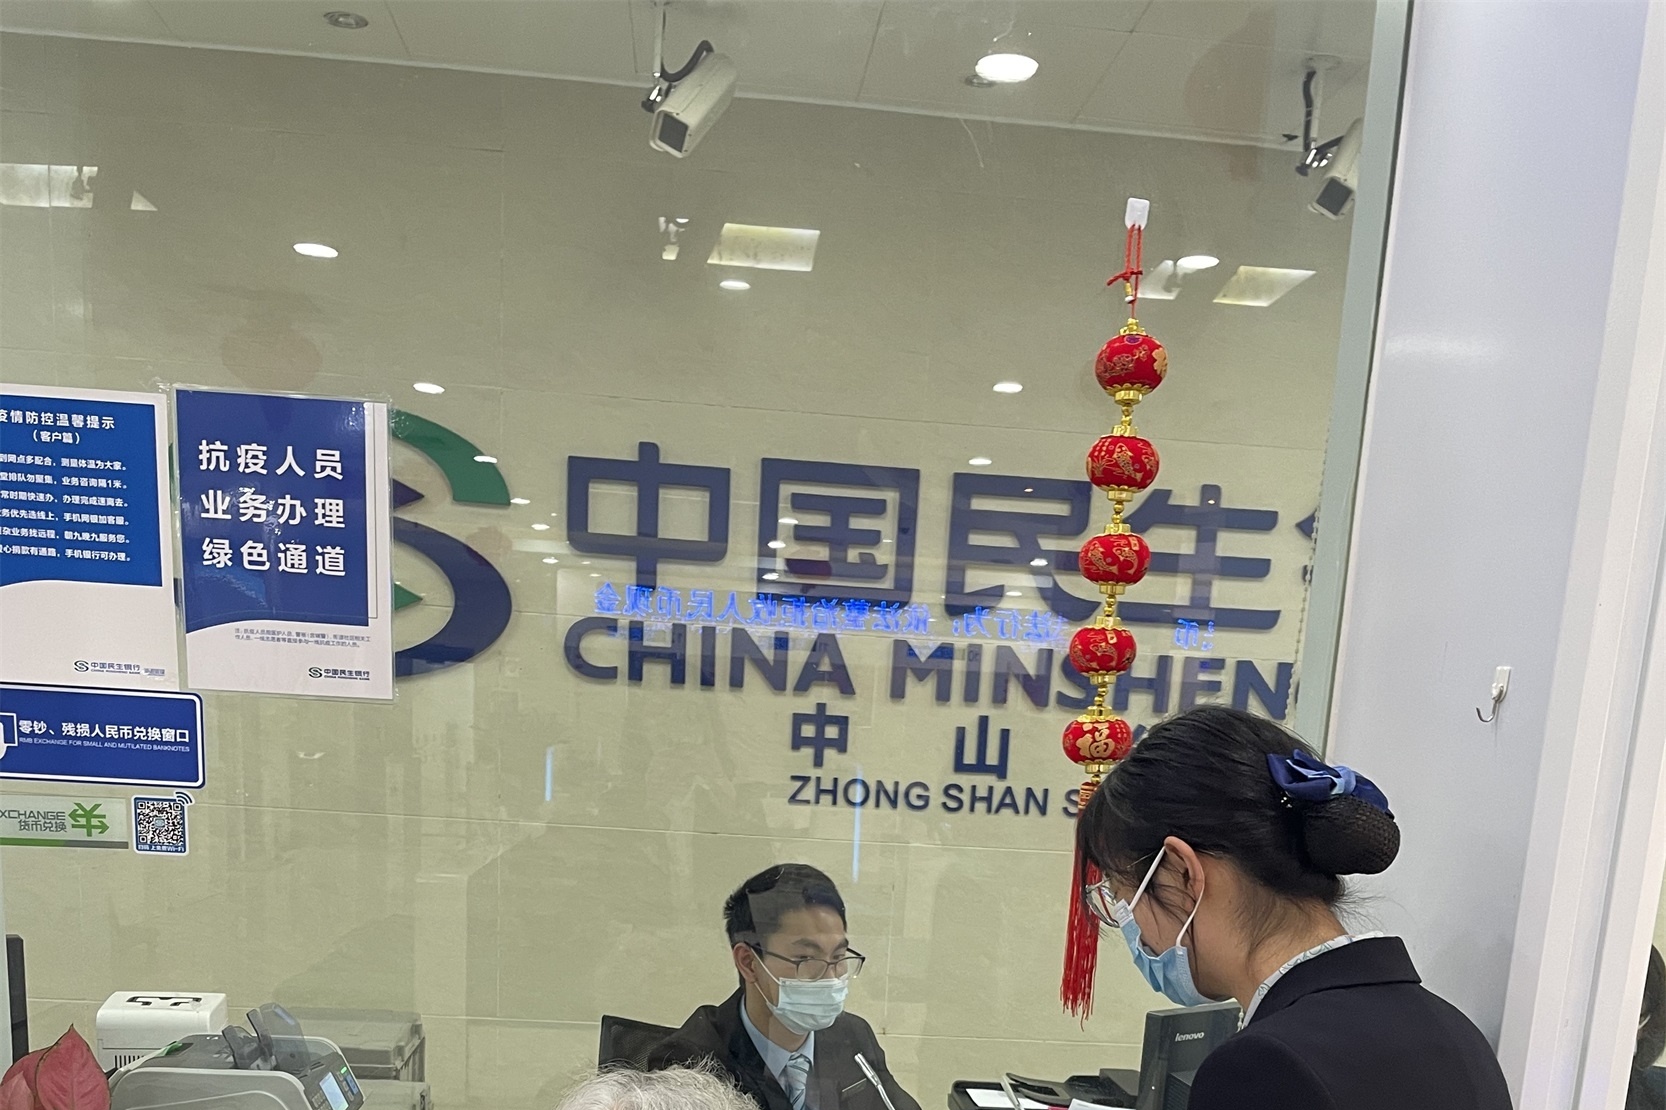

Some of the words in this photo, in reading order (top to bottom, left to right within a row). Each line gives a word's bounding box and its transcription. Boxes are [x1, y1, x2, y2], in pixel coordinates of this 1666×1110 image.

[198, 440, 344, 481] 抗疫人员
[200, 490, 346, 529] 业务办理
[202, 537, 347, 577] 绿色通道
[567, 441, 1316, 634] 中国民生
[564, 617, 855, 697] CHINA
[889, 641, 1299, 720] MINSHEN
[18, 719, 190, 743] 零钞、残损人民币兑换窗口
[33, 738, 68, 746] EXCHANGE
[1075, 721, 1117, 759] 福
[788, 775, 931, 812] ZHONG
[941, 783, 1048, 816] SHAN
[18, 819, 67, 833] 货币兑换
[1174, 1031, 1205, 1042] lenovo
